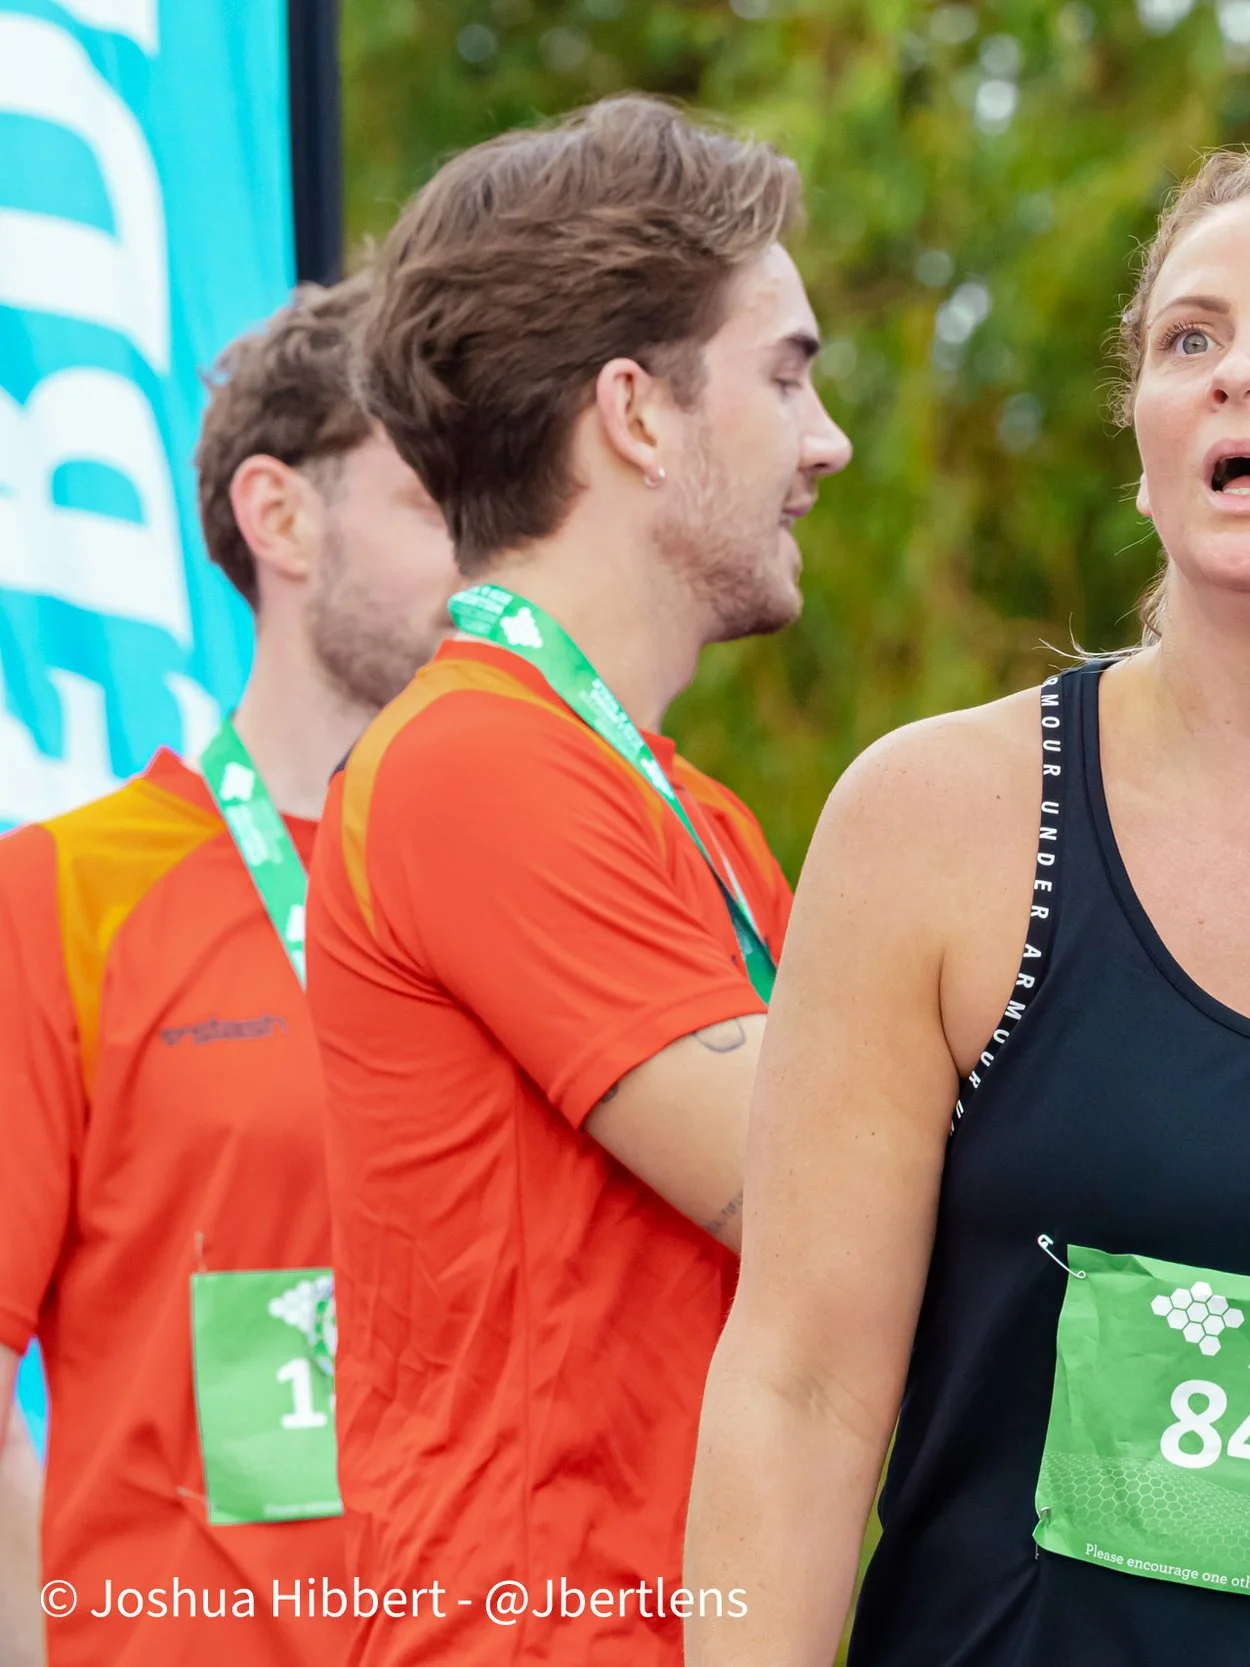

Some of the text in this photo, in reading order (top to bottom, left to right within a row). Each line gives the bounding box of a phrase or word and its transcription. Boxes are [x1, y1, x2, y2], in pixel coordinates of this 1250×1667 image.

[1030, 801, 1060, 920] UNDER
[276, 1357, 336, 1430] 1
[1086, 1543, 1124, 1564] Please
[1126, 1557, 1199, 1581] encourage
[1202, 1571, 1228, 1585] one
